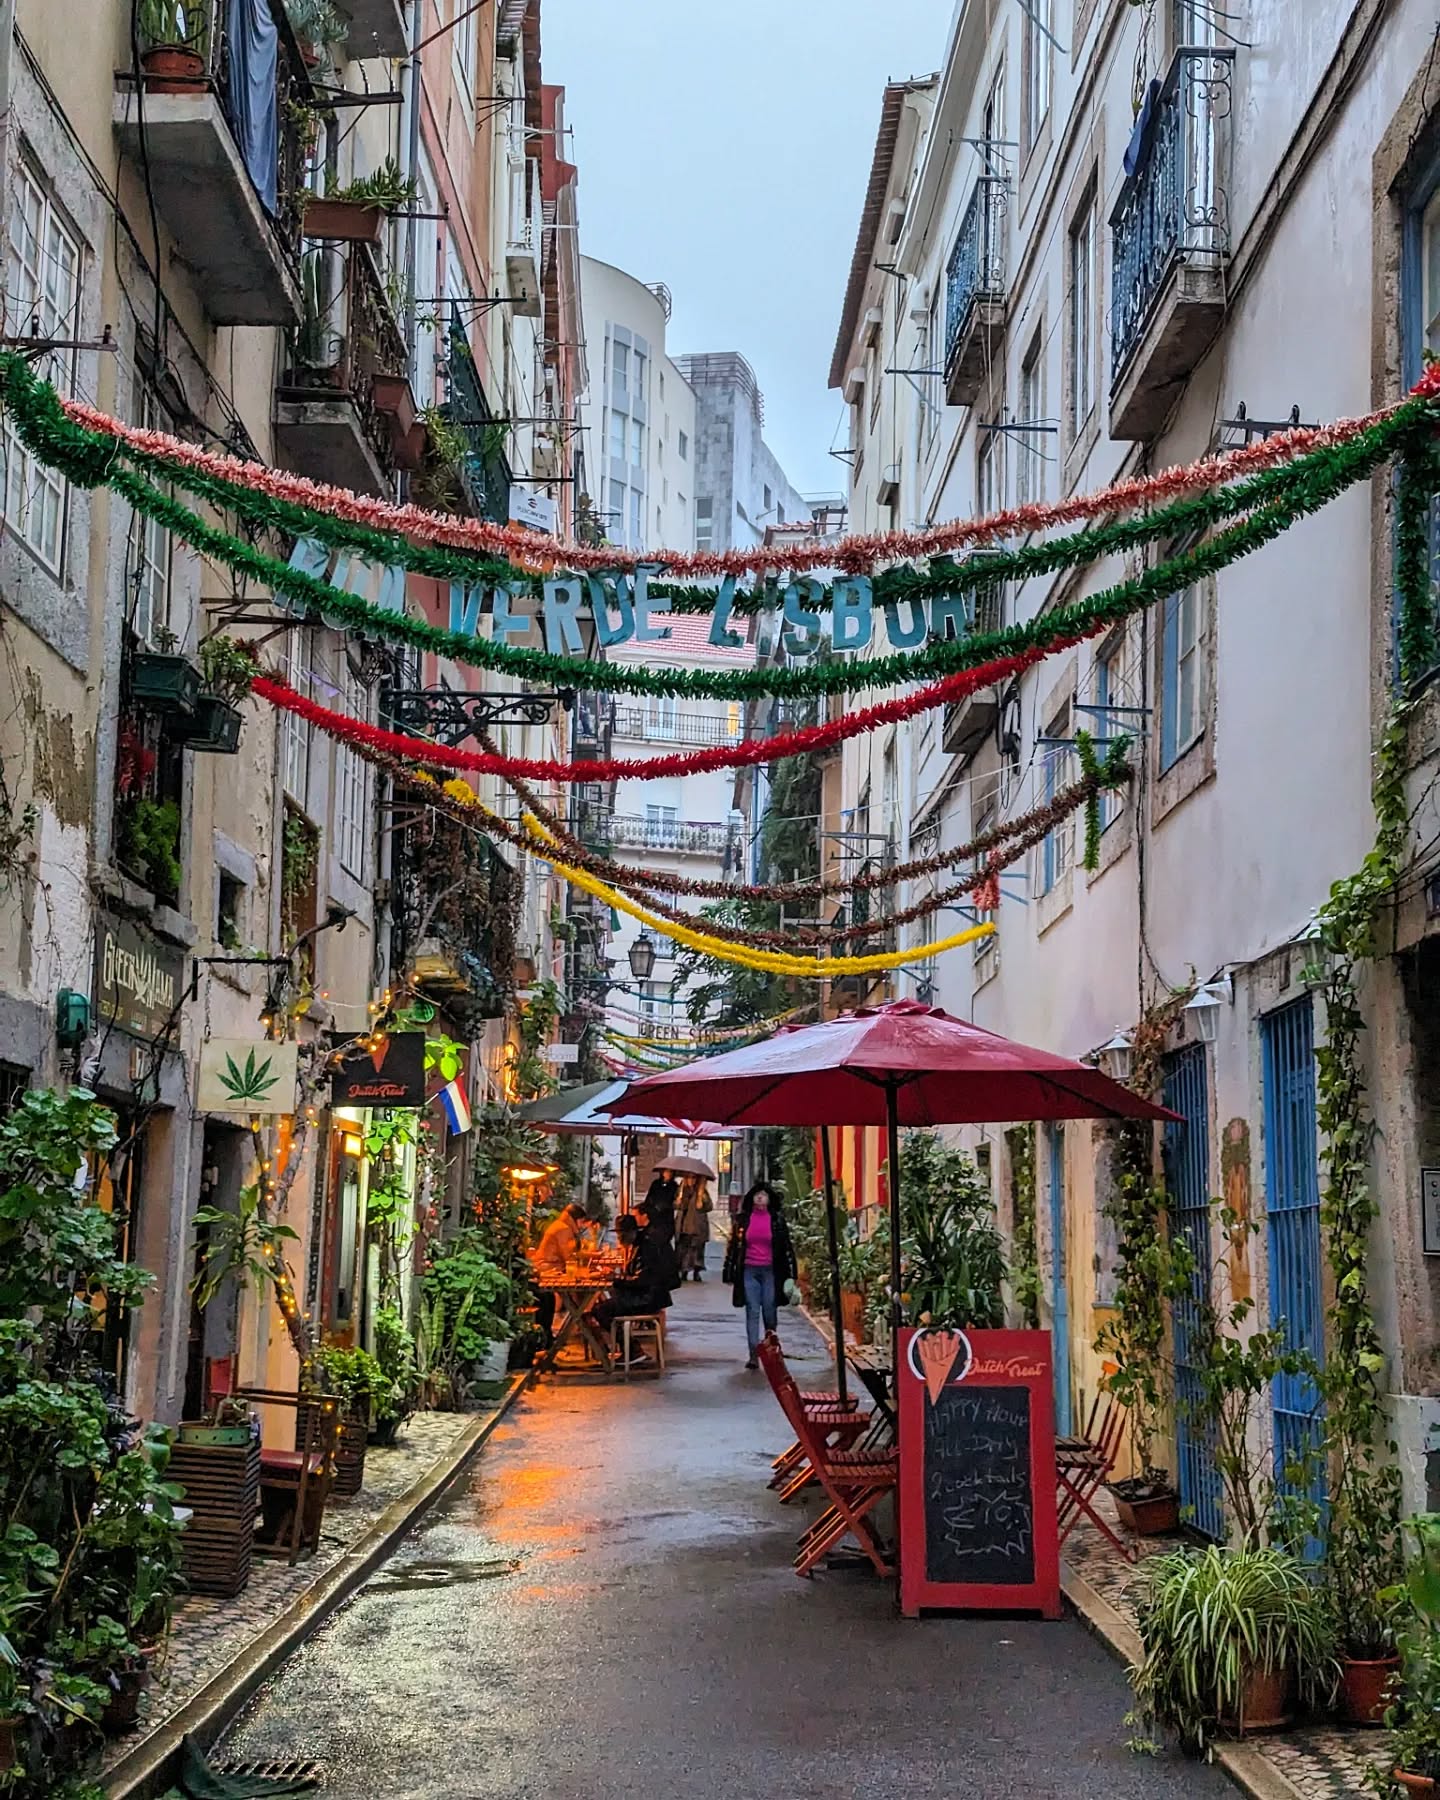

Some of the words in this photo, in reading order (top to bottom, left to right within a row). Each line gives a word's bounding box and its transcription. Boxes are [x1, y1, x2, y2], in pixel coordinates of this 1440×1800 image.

[449, 562, 673, 656] VERDE
[962, 1357, 1005, 1376] Dutch
[1004, 1355, 1047, 1377] Treat
